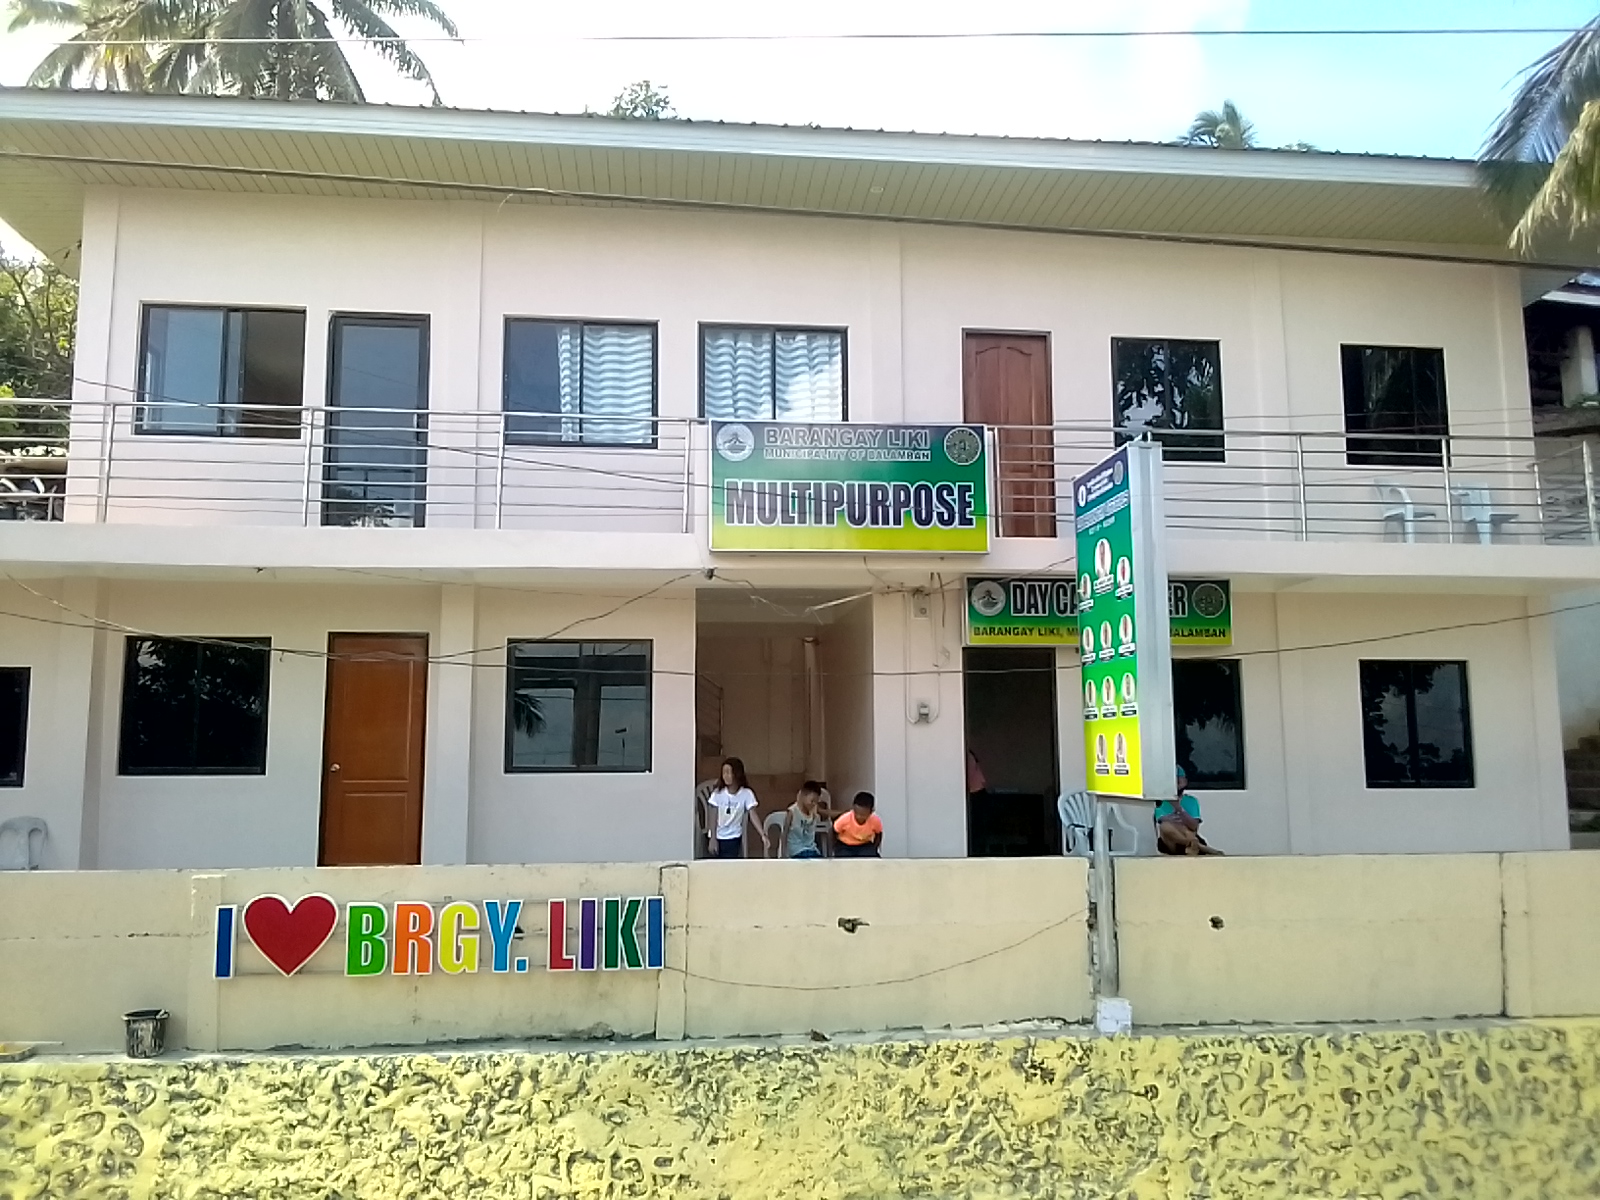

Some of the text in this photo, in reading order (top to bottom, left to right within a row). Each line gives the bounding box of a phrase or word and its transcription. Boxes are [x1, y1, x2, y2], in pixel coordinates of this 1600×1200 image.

[764, 427, 881, 447] BARANGAY
[887, 429, 931, 449] LIKI
[764, 448, 847, 461] MUNICIPALITY
[850, 449, 866, 461] OF
[724, 479, 976, 529] MULTIPURPOSE
[1010, 581, 1051, 617] DAY
[973, 626, 1034, 636] BARANGAY
[214, 896, 665, 981] I BRGY. LIKI
